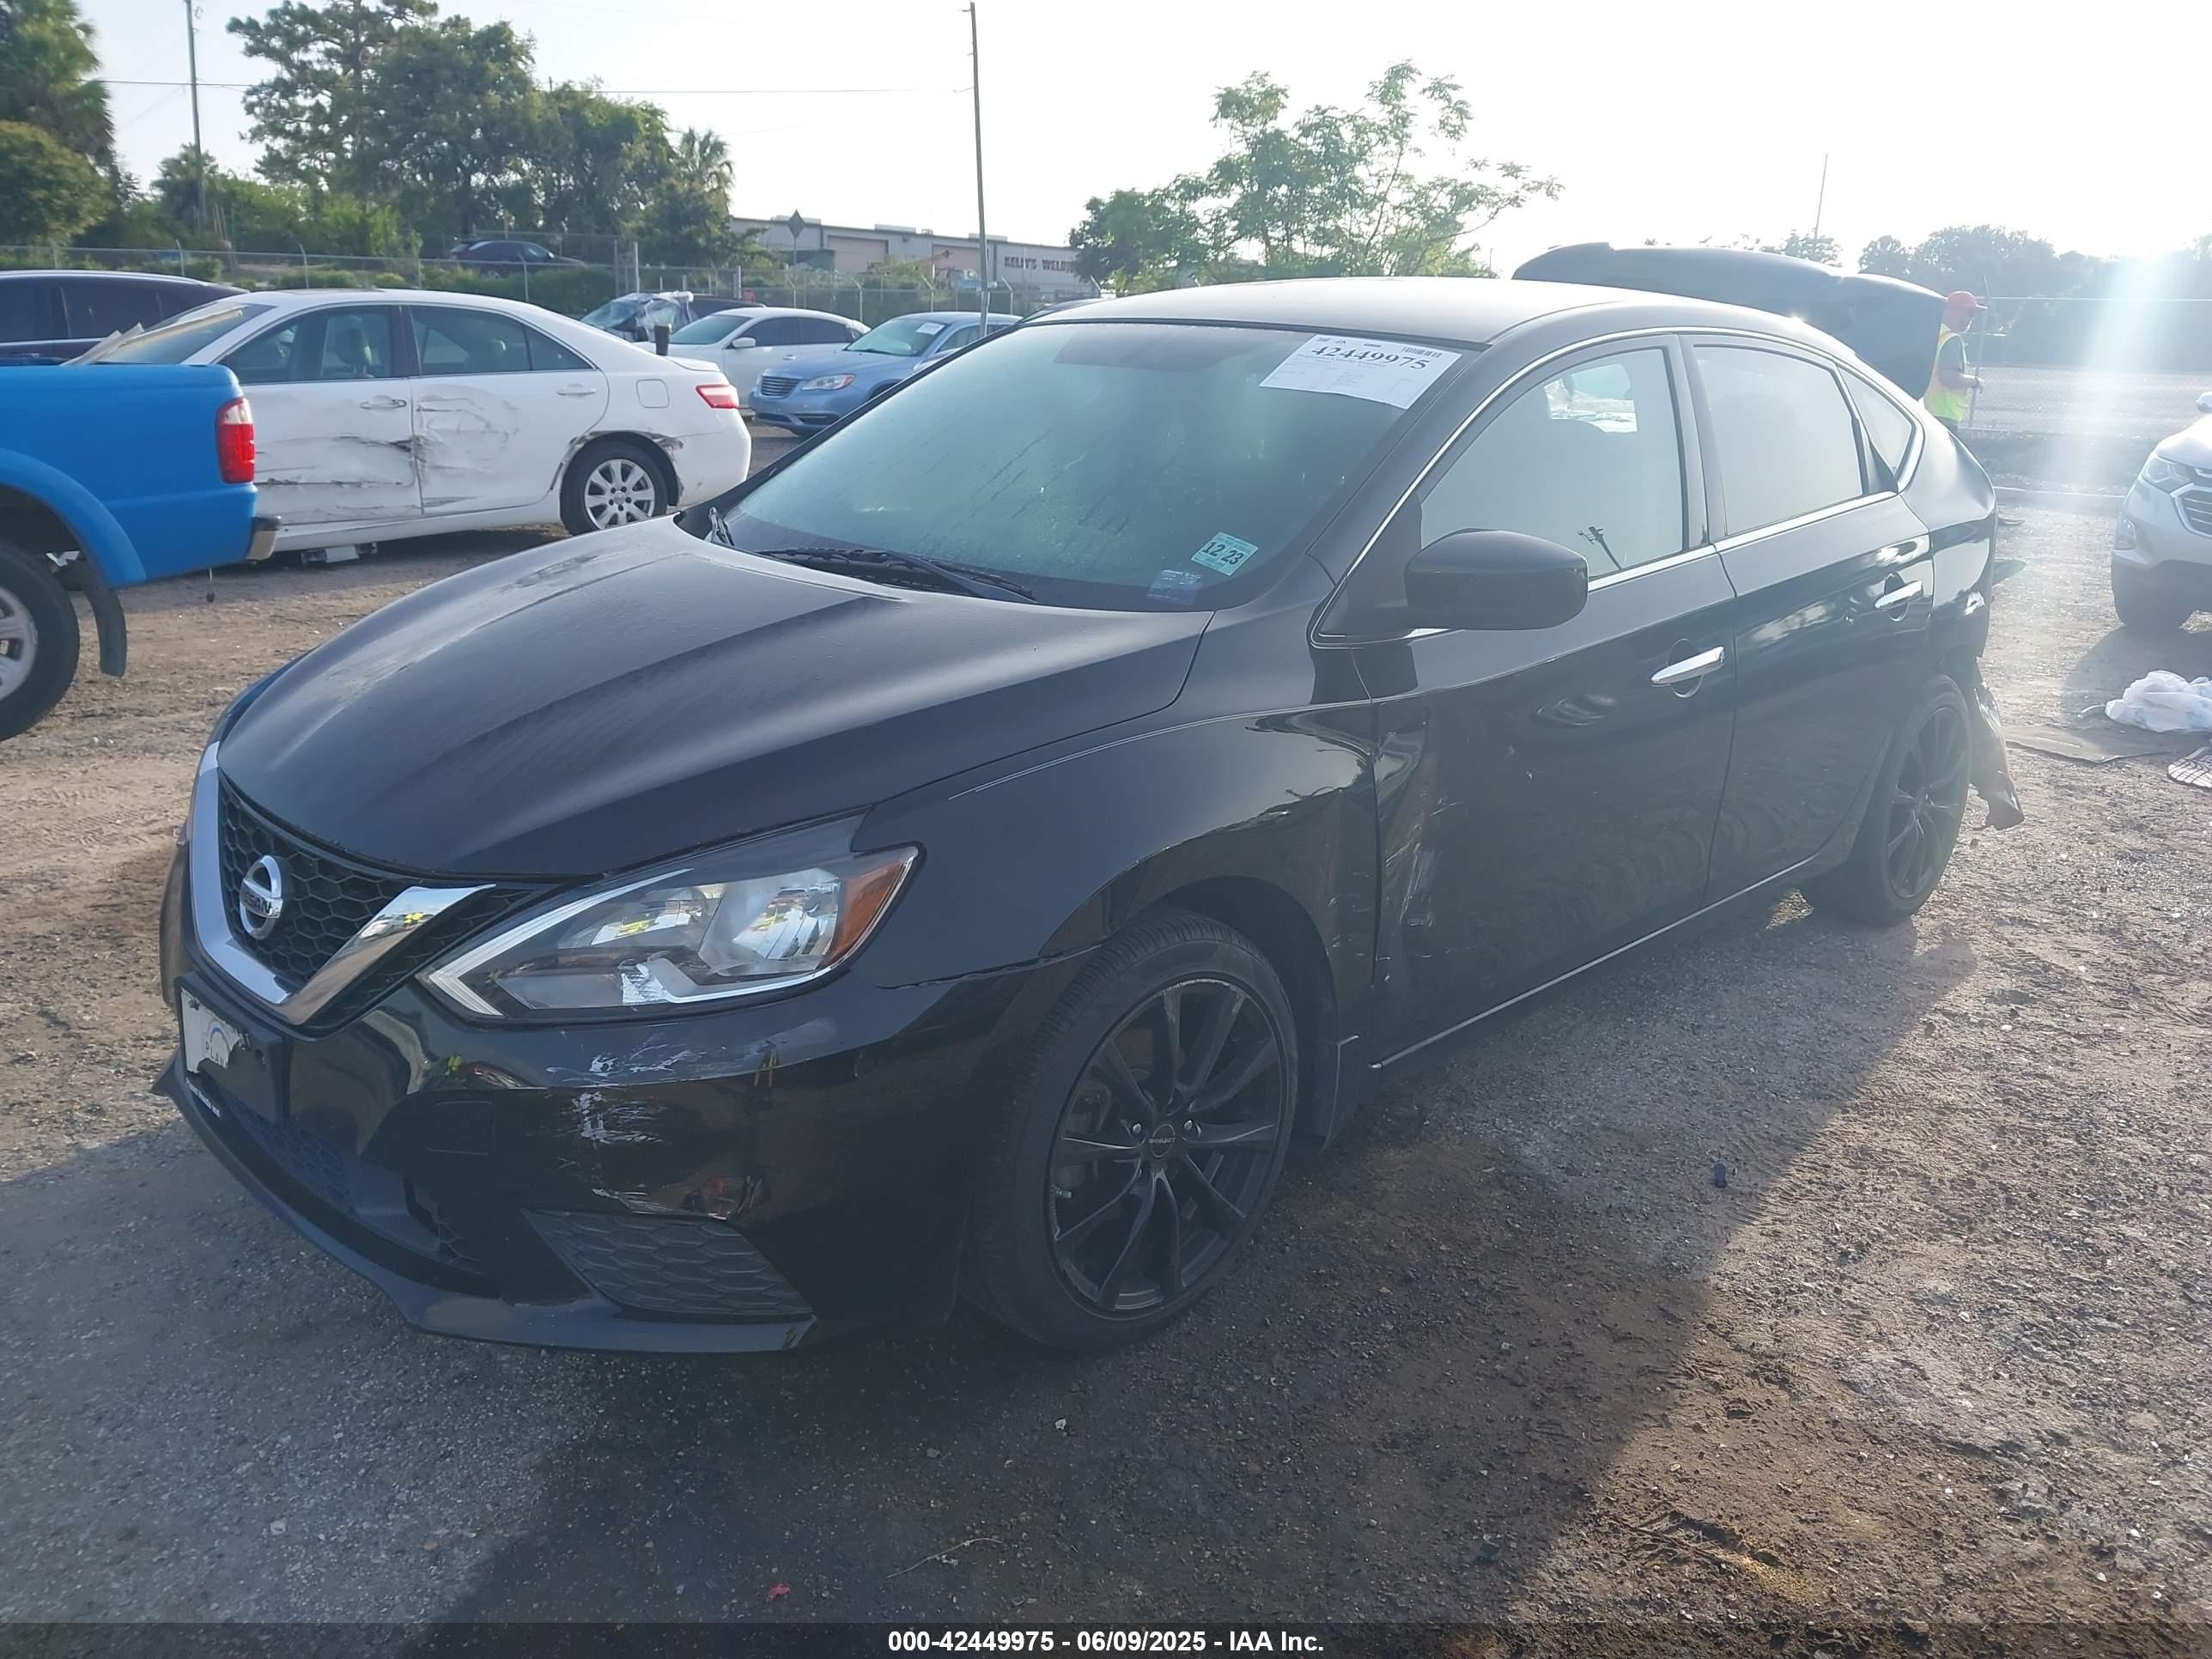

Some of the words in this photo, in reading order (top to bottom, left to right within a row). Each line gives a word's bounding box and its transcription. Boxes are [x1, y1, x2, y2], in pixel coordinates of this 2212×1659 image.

[1310, 345, 1431, 369] 42449975
[1201, 541, 1225, 557] 12
[1220, 550, 1244, 565] 23
